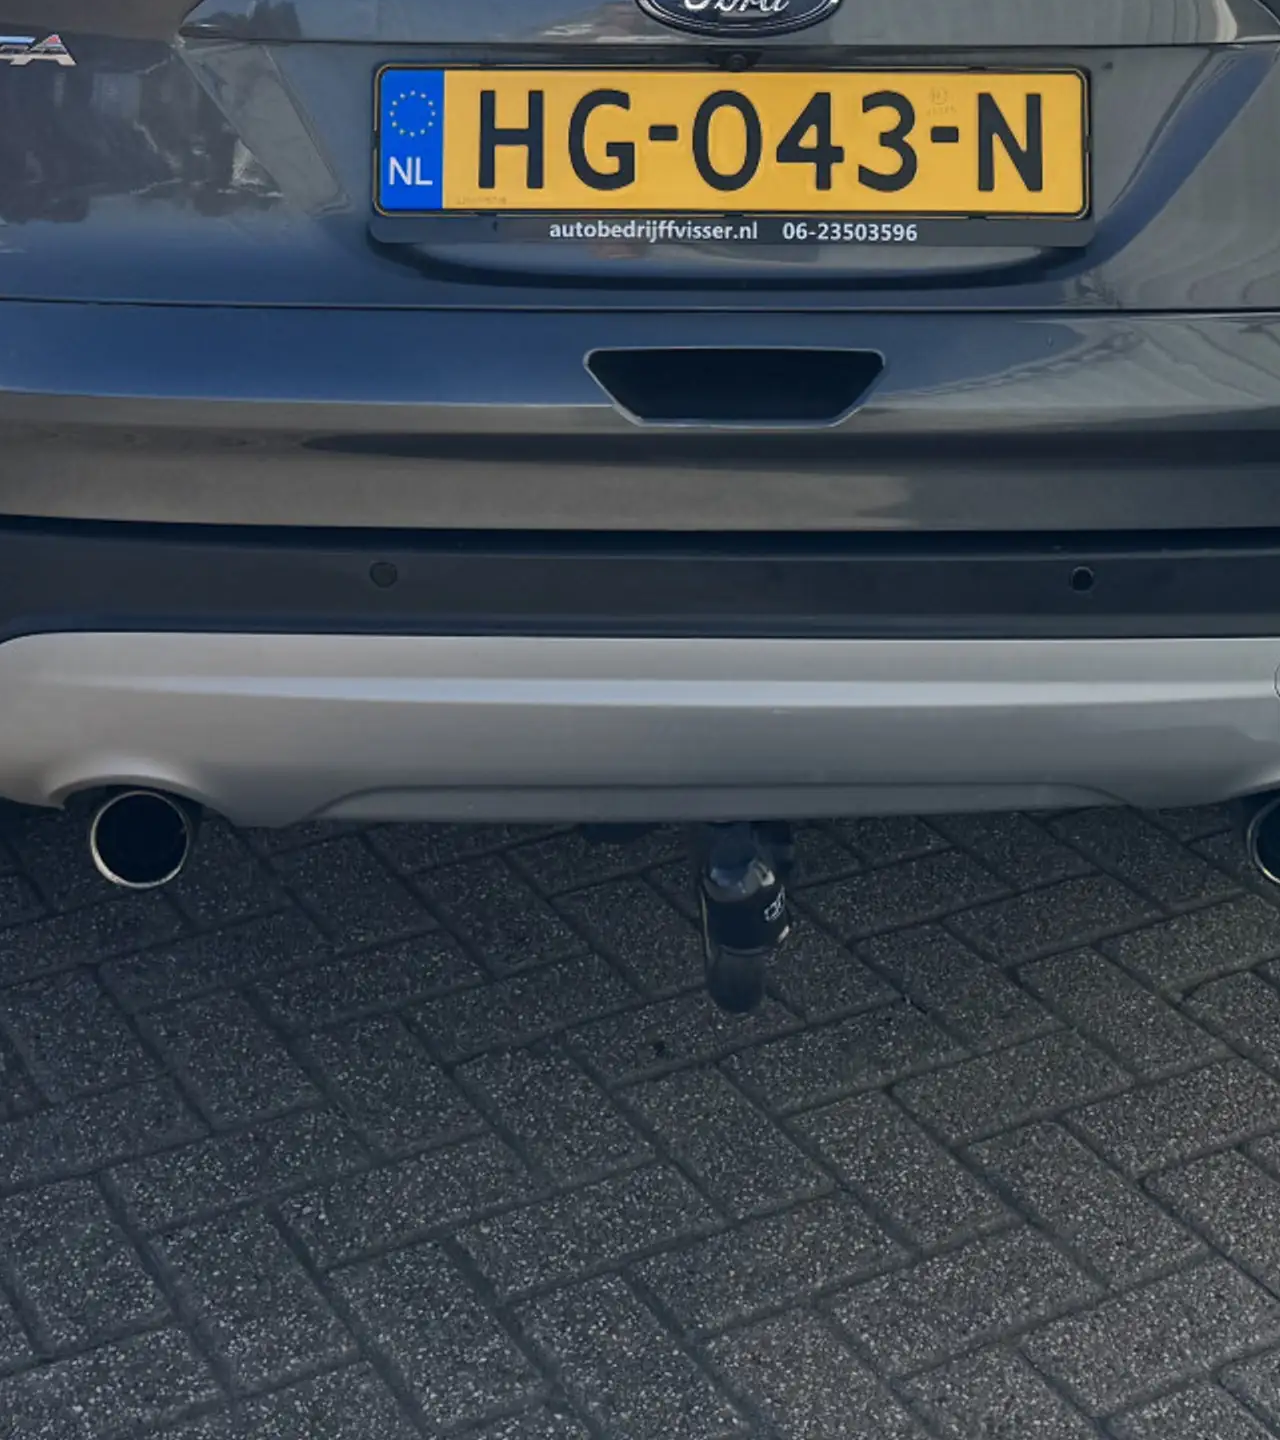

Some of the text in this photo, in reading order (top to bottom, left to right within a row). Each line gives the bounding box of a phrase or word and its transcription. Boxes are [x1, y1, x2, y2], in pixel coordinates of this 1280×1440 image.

[476, 89, 1044, 193] HG-043-N
[388, 156, 434, 186] NL
[549, 220, 918, 243] autobedrijffvisser.nl 06-23503596
